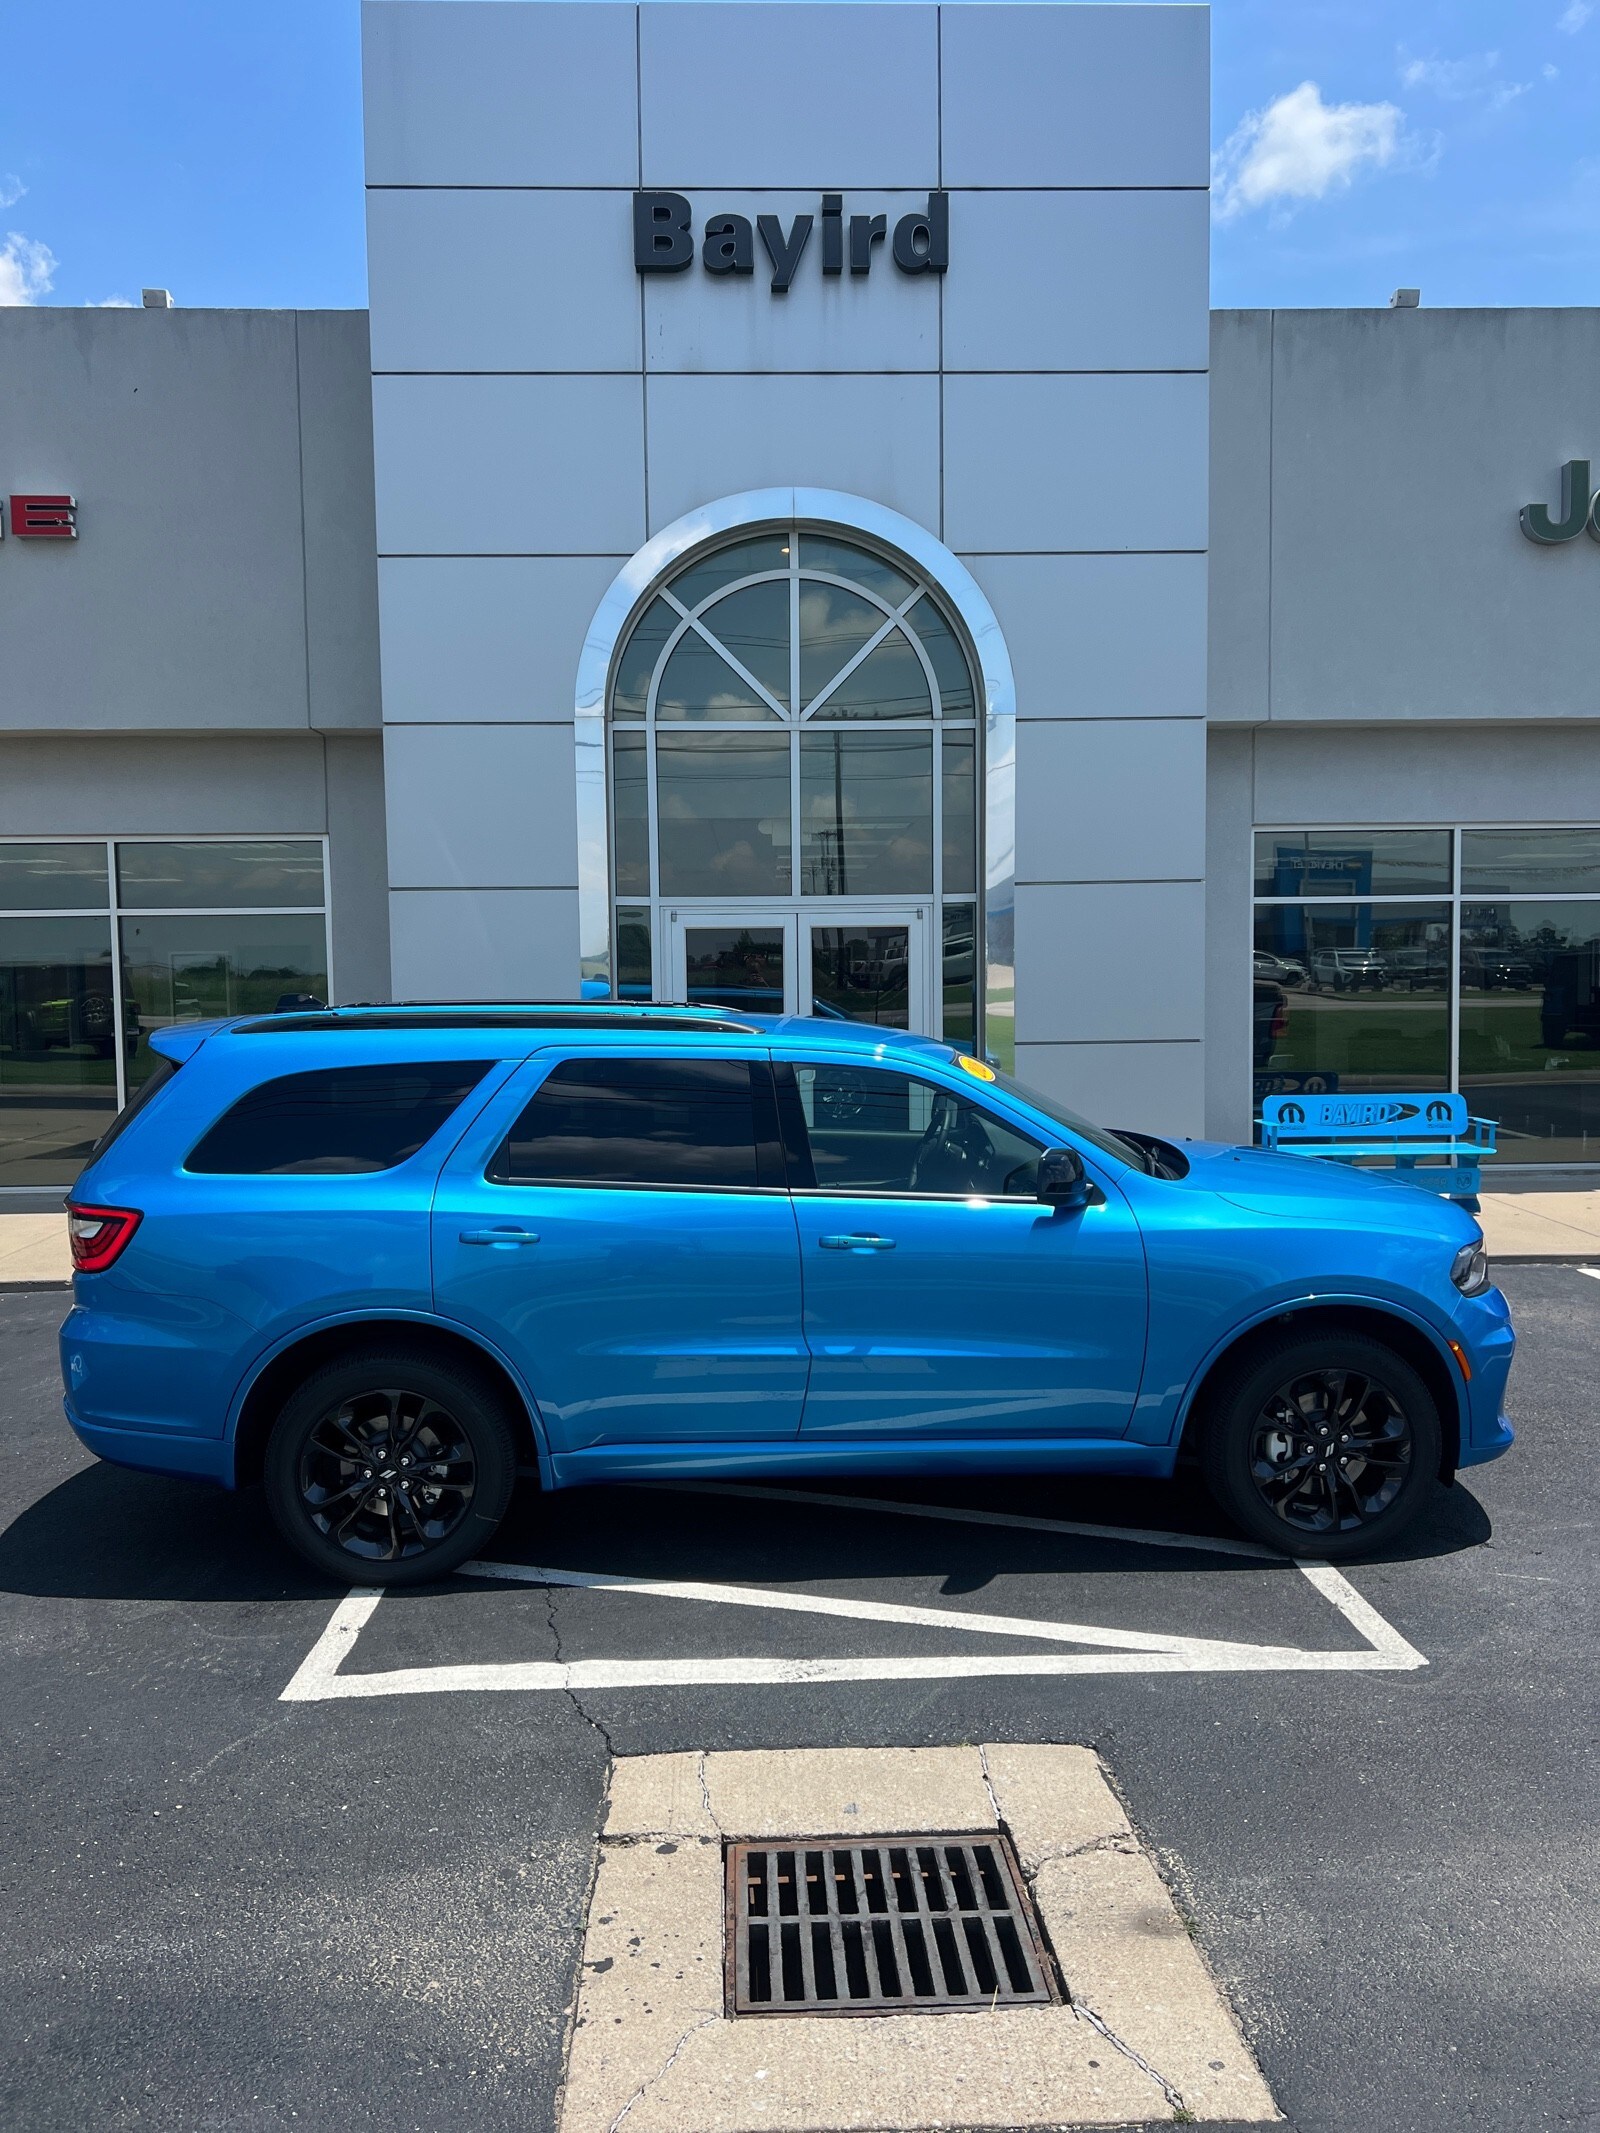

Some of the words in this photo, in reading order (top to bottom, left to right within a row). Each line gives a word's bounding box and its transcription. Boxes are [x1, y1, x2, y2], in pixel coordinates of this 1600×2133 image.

[632, 191, 949, 293] Bayird
[0, 493, 79, 538] E
[1519, 458, 1600, 546] J
[1320, 1103, 1391, 1124] BAYIRD
